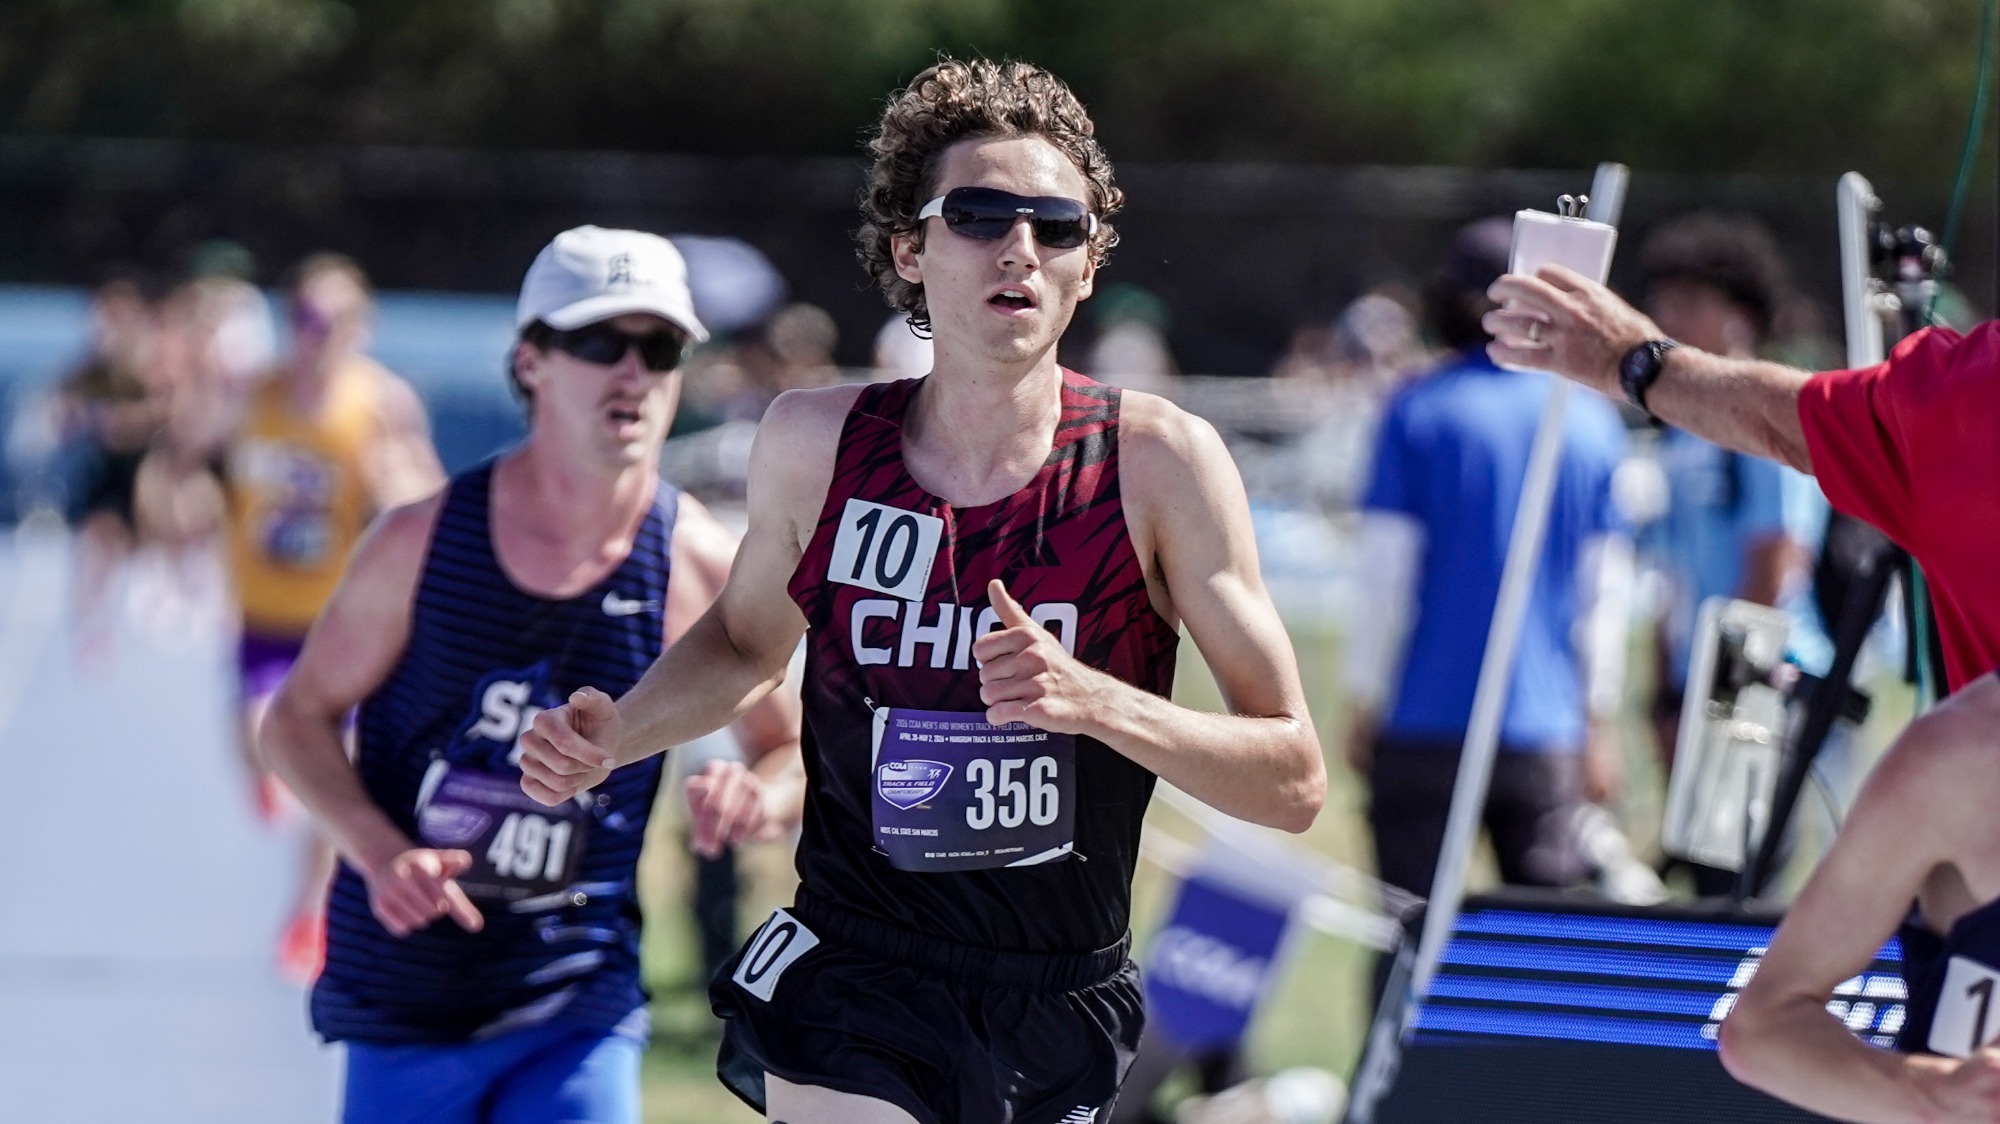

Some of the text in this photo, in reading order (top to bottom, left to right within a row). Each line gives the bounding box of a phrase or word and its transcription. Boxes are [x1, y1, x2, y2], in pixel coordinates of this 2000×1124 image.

[850, 507, 920, 589] 10
[909, 720, 921, 729] CCAA
[922, 721, 938, 730] MEN'S
[939, 722, 949, 731] AND
[950, 722, 974, 731] WOMEN'S
[975, 722, 992, 731] TRACK
[972, 735, 987, 743] TRACK
[1006, 735, 1015, 743] SAN
[889, 761, 907, 770] CCAA
[966, 756, 1059, 830] 356
[891, 827, 899, 835] CAL
[900, 827, 911, 836] STATE
[911, 828, 920, 836] SAN
[486, 812, 574, 882] 491
